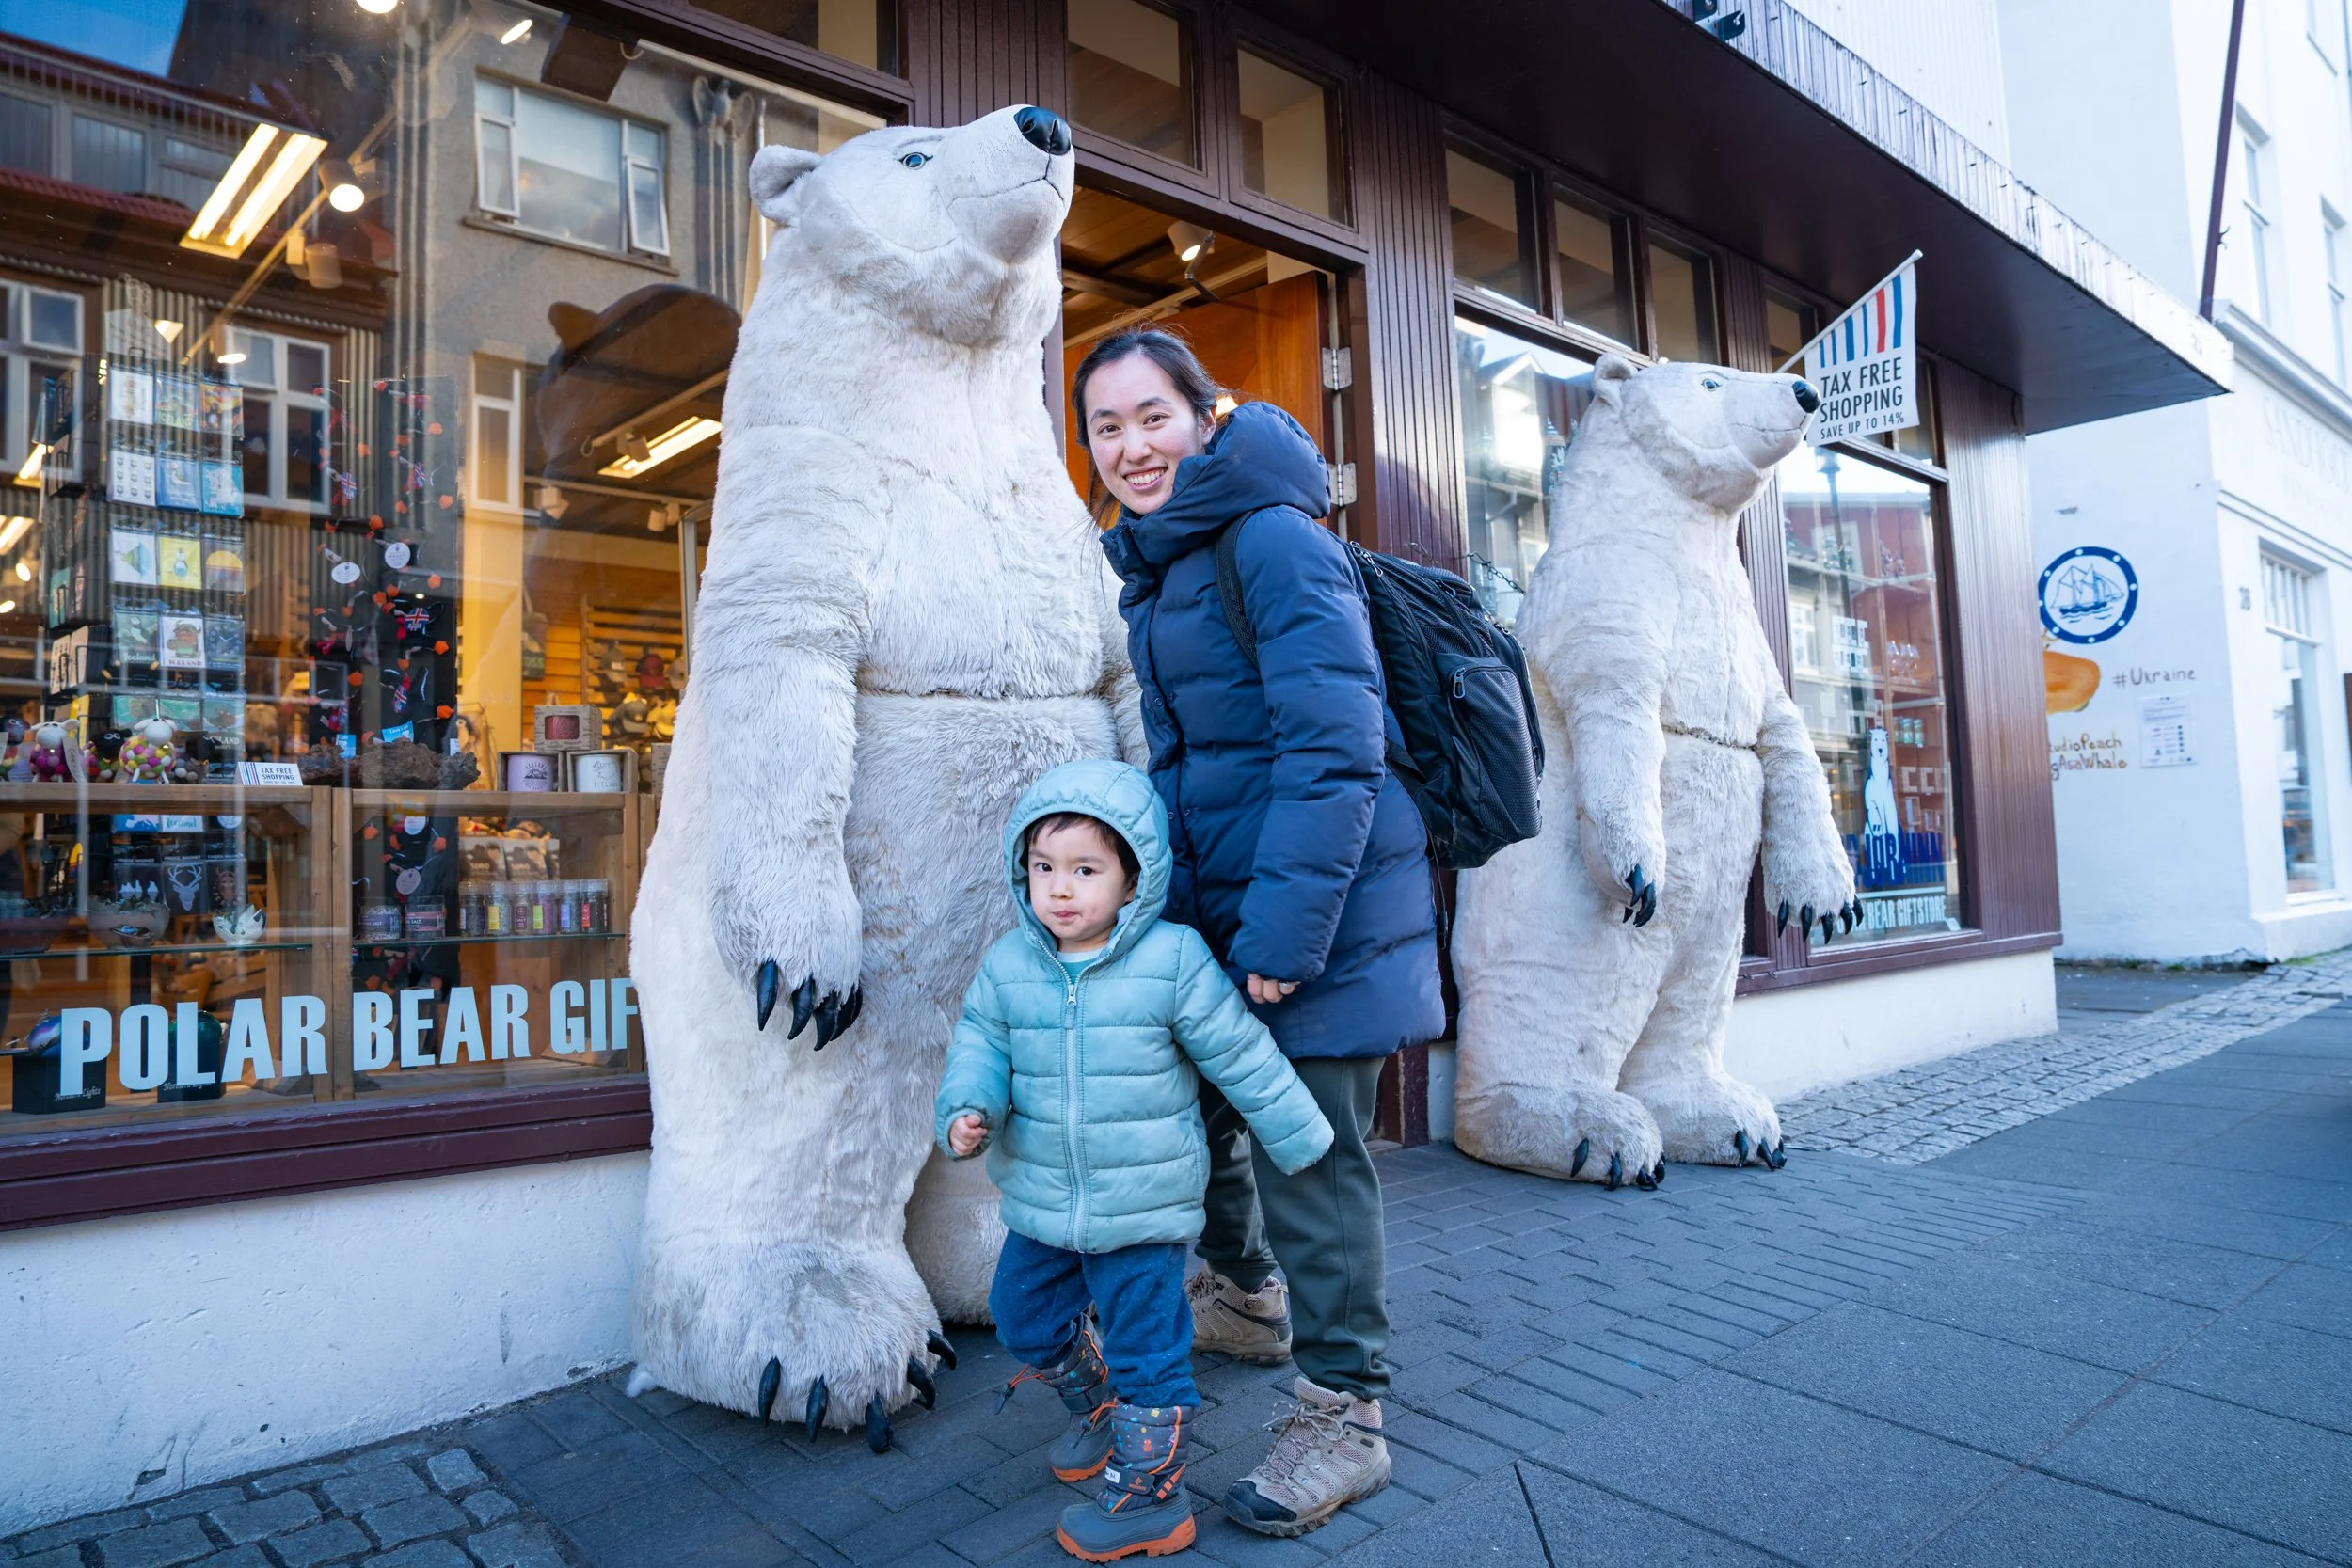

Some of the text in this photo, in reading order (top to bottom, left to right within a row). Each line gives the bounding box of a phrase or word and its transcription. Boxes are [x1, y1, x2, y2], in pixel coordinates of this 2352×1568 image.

[1820, 356, 1902, 399] TAX FREE
[1820, 385, 1904, 423] SHOPPING
[1820, 412, 1905, 440] SAVE UP TO 14%
[2111, 666, 2198, 689] #Ukraine
[1867, 899, 1897, 930] BEAR
[1897, 895, 1947, 927] GIFTSTORE
[59, 995, 329, 1097] POLAR
[353, 983, 532, 1072] BEAR
